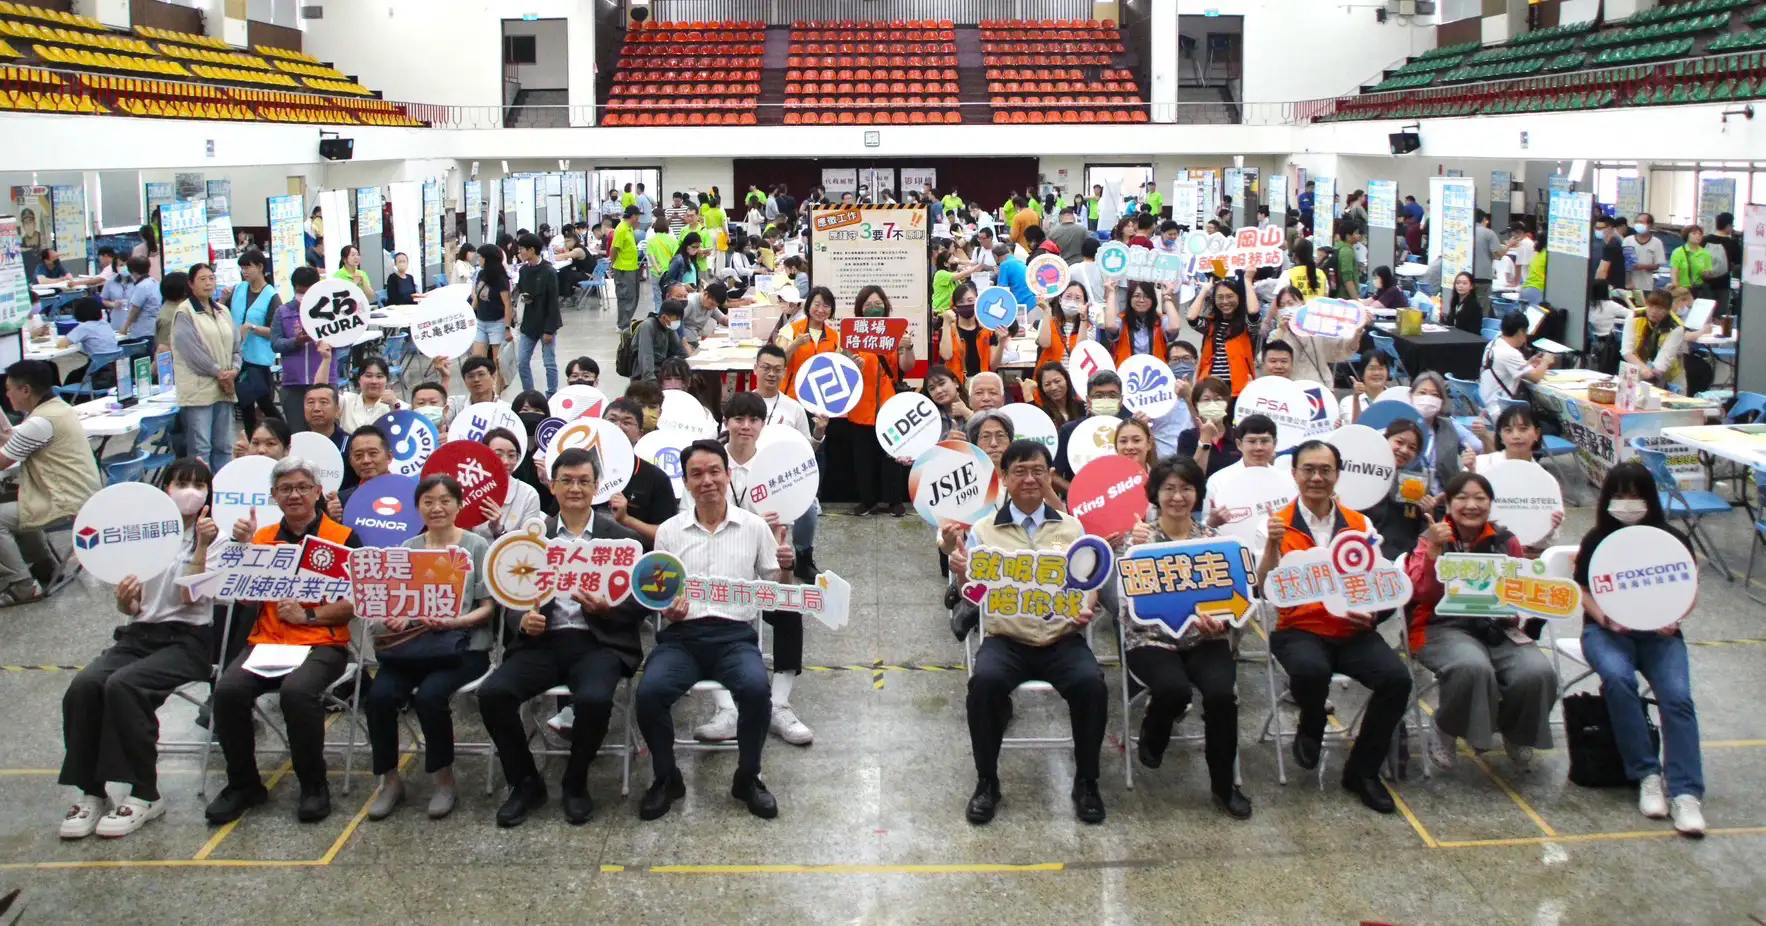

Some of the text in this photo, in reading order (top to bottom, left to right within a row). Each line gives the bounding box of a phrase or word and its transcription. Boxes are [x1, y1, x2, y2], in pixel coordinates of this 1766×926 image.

[817, 211, 857, 228] 應徵工作
[1237, 227, 1282, 249] 岡山
[308, 290, 358, 321] くら
[315, 314, 364, 339] KURA
[853, 319, 886, 334] 職場
[845, 335, 895, 350] 陪你聊
[1127, 390, 1172, 408] Vinda
[1256, 397, 1289, 413] PSA
[468, 415, 487, 441] SE
[882, 401, 932, 446] IDEC
[400, 427, 431, 475] GILLION
[320, 470, 339, 479] EMS
[598, 477, 623, 495] inFlex
[929, 461, 978, 506] JSIE
[213, 492, 265, 505] TSLG
[460, 479, 498, 508] AI TOWN
[955, 485, 979, 506] 1990
[1072, 474, 1143, 517] King Slide
[103, 520, 180, 544] 台灣福興
[355, 517, 408, 531] HONOR
[218, 546, 296, 570] 勞工局
[354, 549, 412, 580] 我是
[546, 545, 636, 567] 有人帶路
[969, 550, 1067, 587] 就服員
[1439, 559, 1522, 581] 你的人才
[1616, 562, 1687, 580] FOXCONN
[220, 574, 352, 600] 訓練就業中
[534, 571, 602, 592] 不迷路
[1273, 564, 1402, 603] 我們要你
[1504, 578, 1573, 609] 已上線
[356, 583, 457, 618] 潛力股
[685, 579, 824, 611] 高雄市勞工局
[988, 585, 1084, 619] 陪你找
